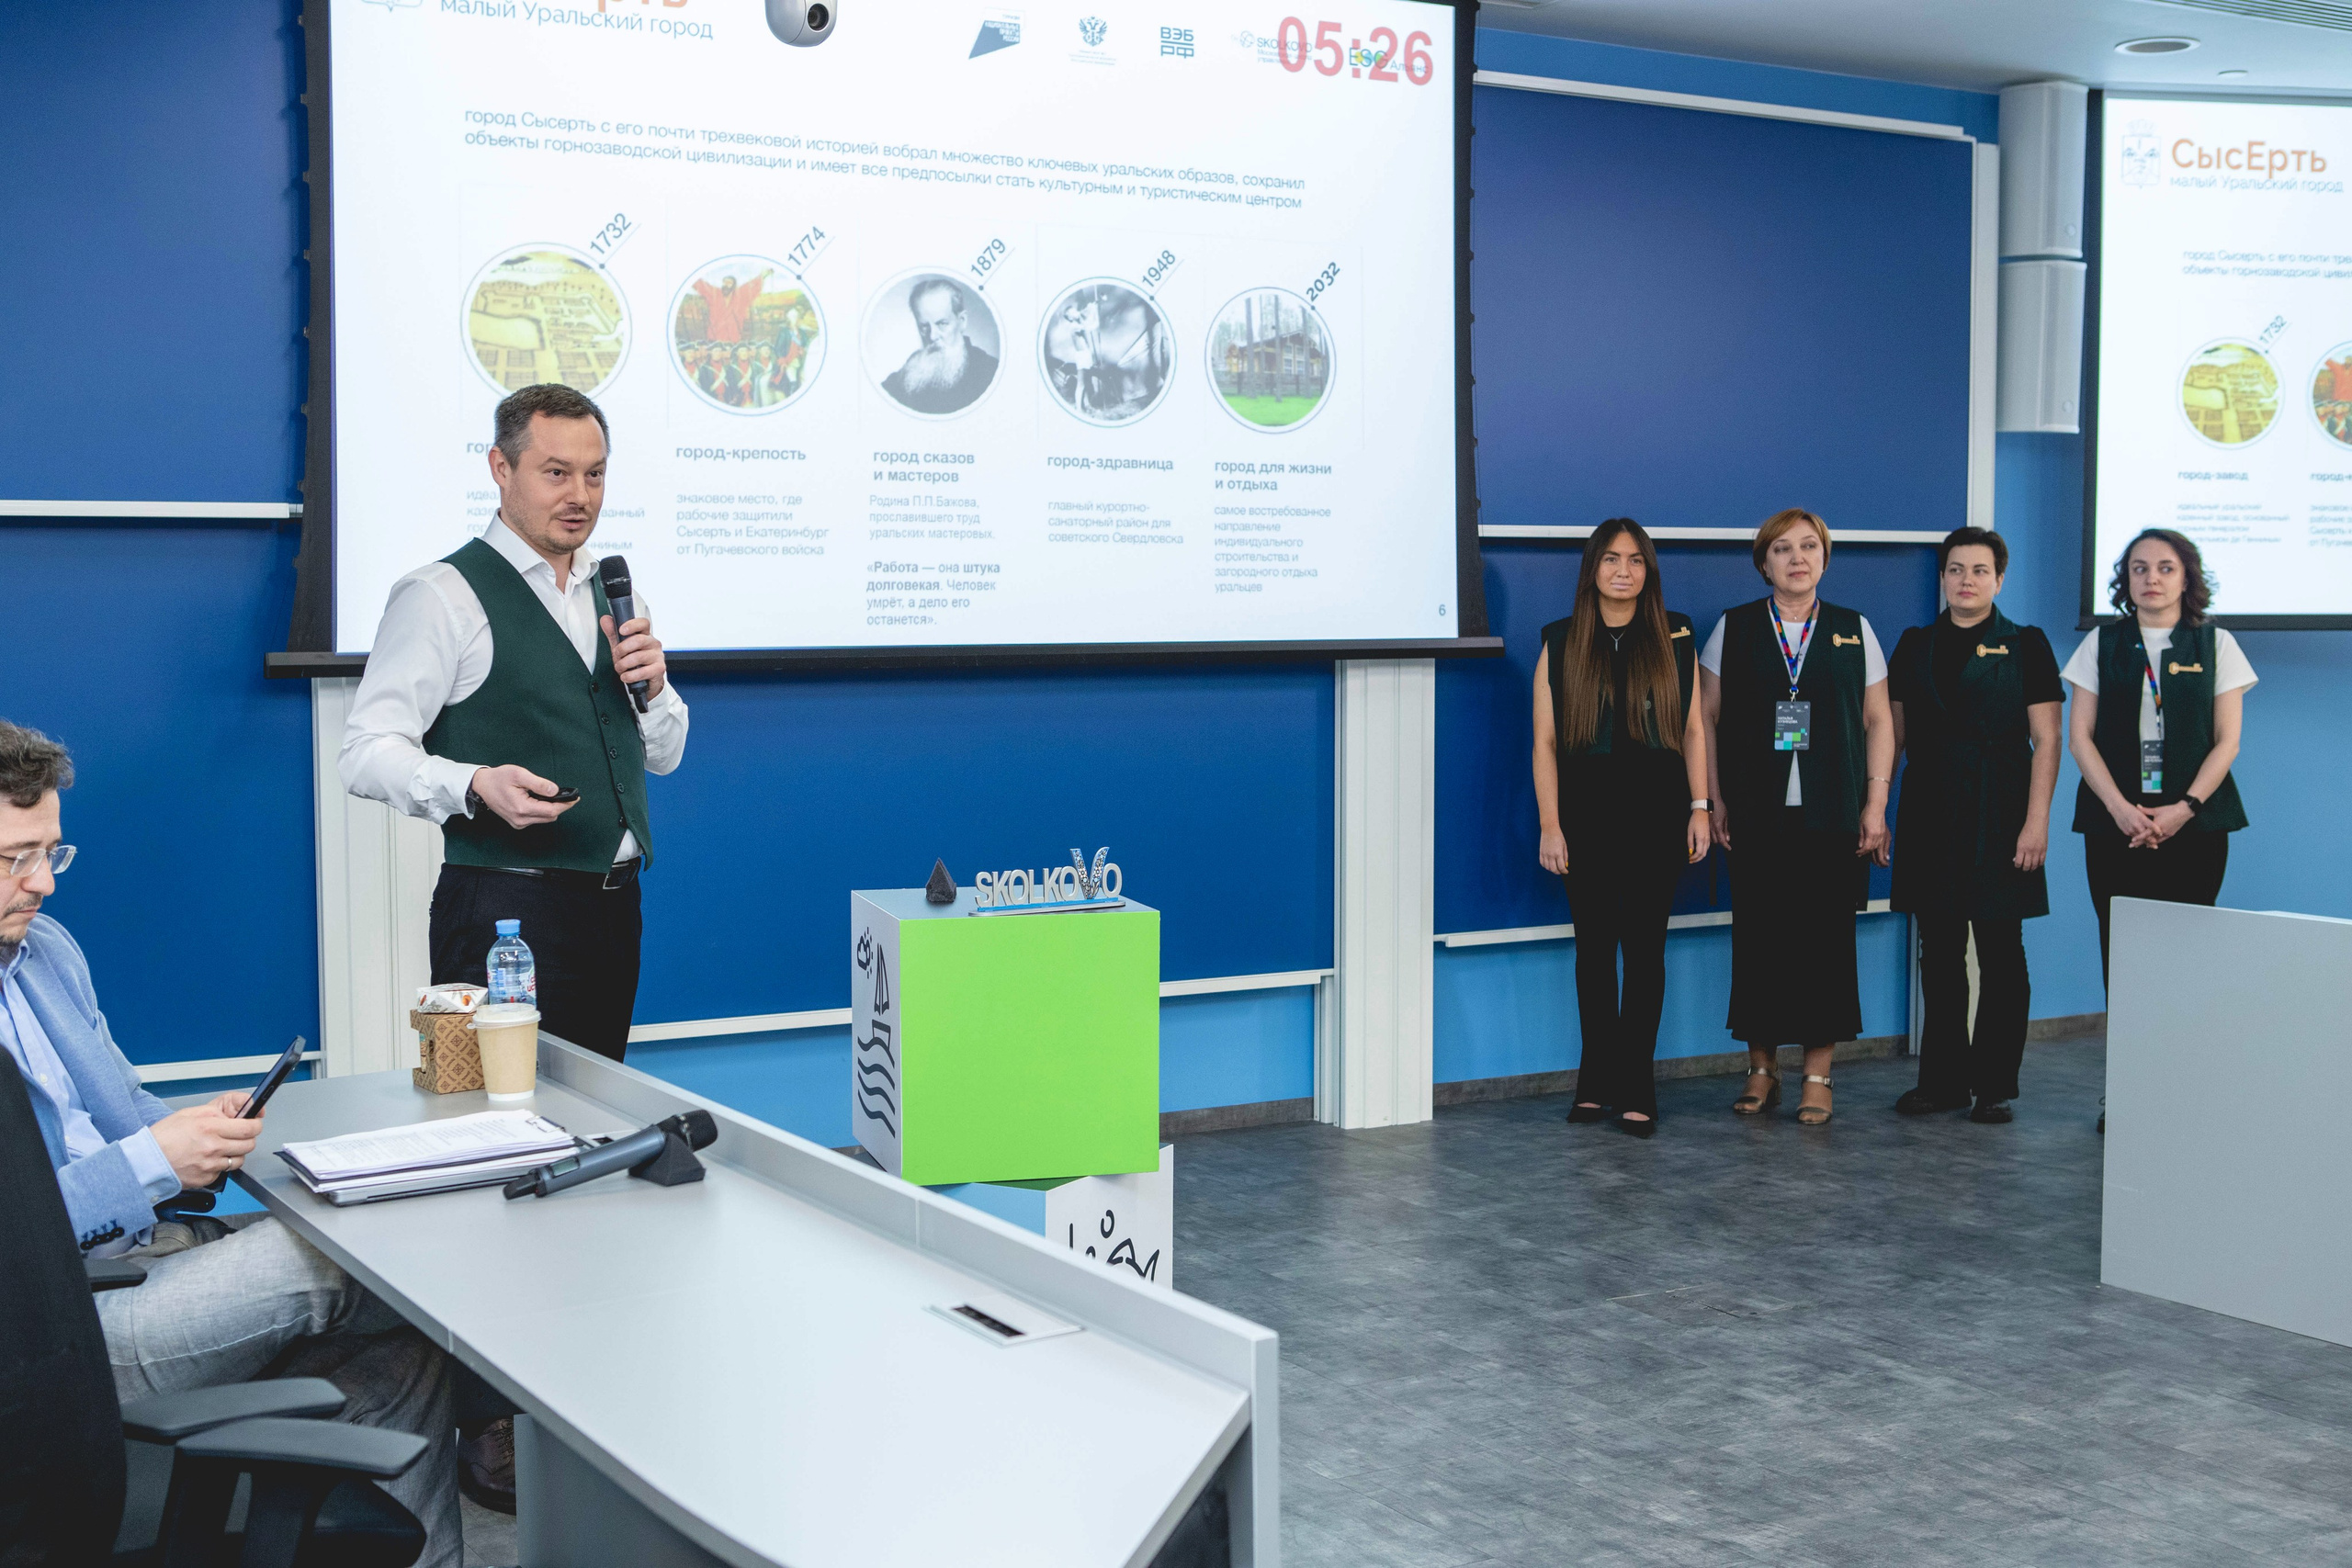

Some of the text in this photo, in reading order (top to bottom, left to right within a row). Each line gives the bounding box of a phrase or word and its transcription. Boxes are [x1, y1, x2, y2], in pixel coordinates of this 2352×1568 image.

[441, 0, 516, 18] малый
[523, 1, 643, 31] Уральский
[650, 18, 714, 39] город
[1160, 27, 1194, 42] ВЭБ
[1160, 45, 1194, 59] РФ
[1278, 17, 1433, 86] 05:26
[465, 110, 1305, 189] город Сысерть с его почти трехвековой историей вобрал множество ключевых уральских образов, сохранил
[2172, 139, 2327, 179] СысЕрть
[465, 130, 1302, 209] объекты горнозаводской цивилизации и имеет все предпосылки стать культурным и туристическим центром
[590, 212, 632, 255] 1732
[787, 226, 826, 267] 1774
[970, 237, 1007, 278] 1879
[1141, 248, 1176, 288] 1948
[1306, 260, 1340, 301] 2032
[2259, 315, 2287, 344] 1732
[676, 447, 806, 462] город-крепость
[874, 452, 975, 465] город сказов
[1047, 457, 1173, 471] город-здравница
[1215, 462, 1331, 475] город для жизни
[874, 471, 959, 484] и мастеров
[1216, 480, 1278, 491] и отдыха
[676, 494, 802, 506] знаковое место, где
[870, 495, 979, 508] Родина П.П.Бажова,
[676, 509, 793, 522] рабочие защитили
[869, 513, 980, 525] прославившего труд
[676, 525, 731, 539] Сысерть
[746, 525, 830, 540] Екатеринбург
[869, 529, 996, 541] уральских мастеровых.
[677, 543, 824, 558] от Пугачевского войска
[867, 561, 918, 572] «Работа
[939, 564, 959, 572] она
[964, 564, 1001, 576] штука
[866, 580, 995, 592] долговекая. Человек
[867, 597, 970, 610] умрёт, а дело его
[1439, 604, 1446, 616] 6
[867, 615, 937, 625] останется».
[975, 847, 1123, 908] SKOLKOVO
